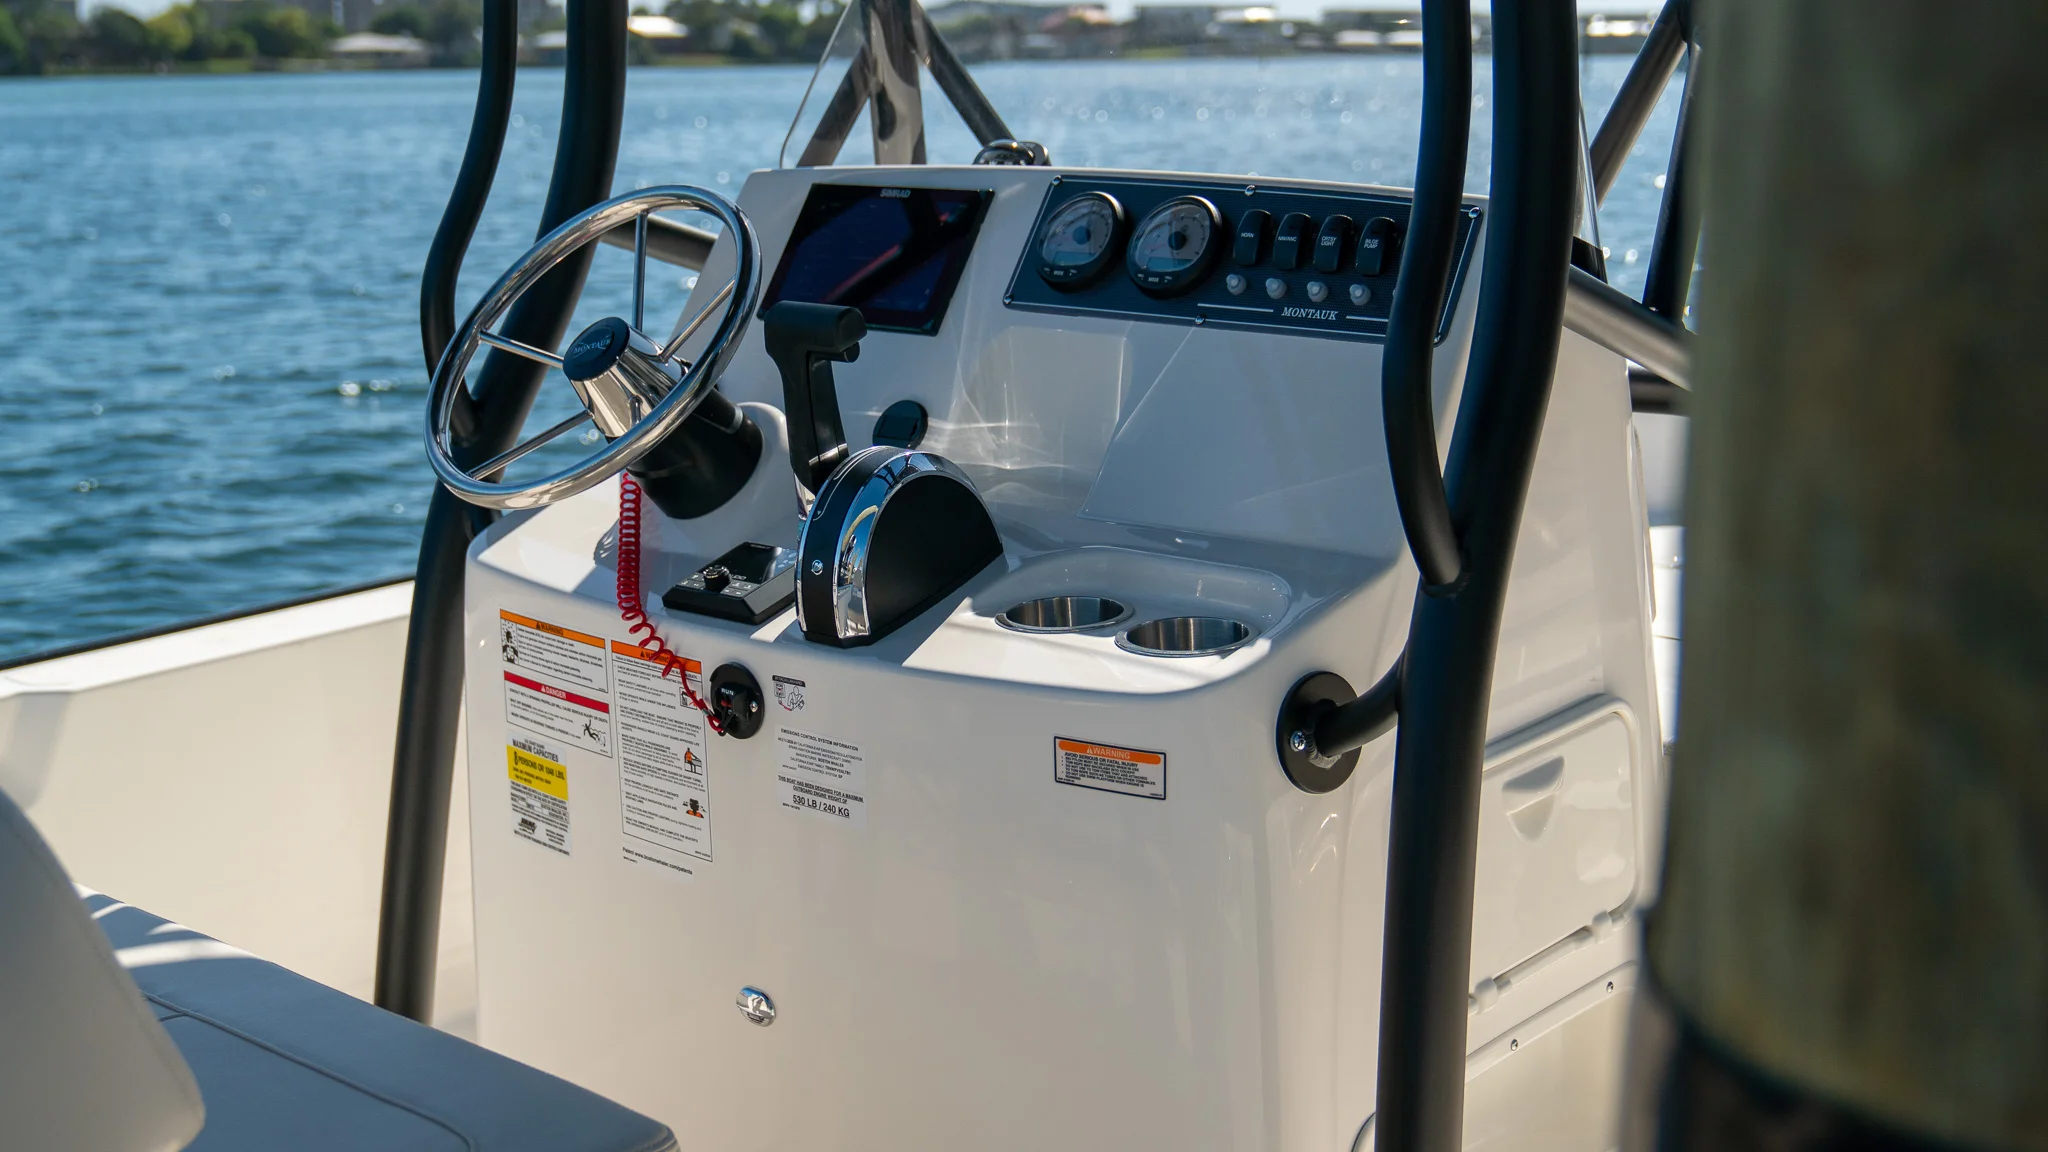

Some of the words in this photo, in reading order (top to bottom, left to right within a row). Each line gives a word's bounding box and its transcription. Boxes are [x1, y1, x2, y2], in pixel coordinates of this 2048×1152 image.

[880, 188, 912, 198] SIMRAD
[1281, 306, 1338, 320] MONTAUK
[573, 338, 612, 354] MONTAUK
[541, 623, 564, 636] WARNING
[546, 687, 566, 699] DANGER
[781, 729, 800, 737] EMISSIONS
[833, 742, 858, 751] INFORMATION
[513, 739, 532, 752] MAXIMUM
[533, 746, 558, 762] CAPACITIES
[1093, 747, 1130, 759] WARNING
[518, 756, 537, 769] PERSONS
[538, 763, 544, 772] OR
[793, 785, 813, 795] OUTBOARD
[815, 785, 832, 794] DESIGNED
[793, 794, 805, 805] 530
[808, 798, 817, 808] LB
[823, 803, 836, 814] 240
[838, 807, 849, 817] KG
